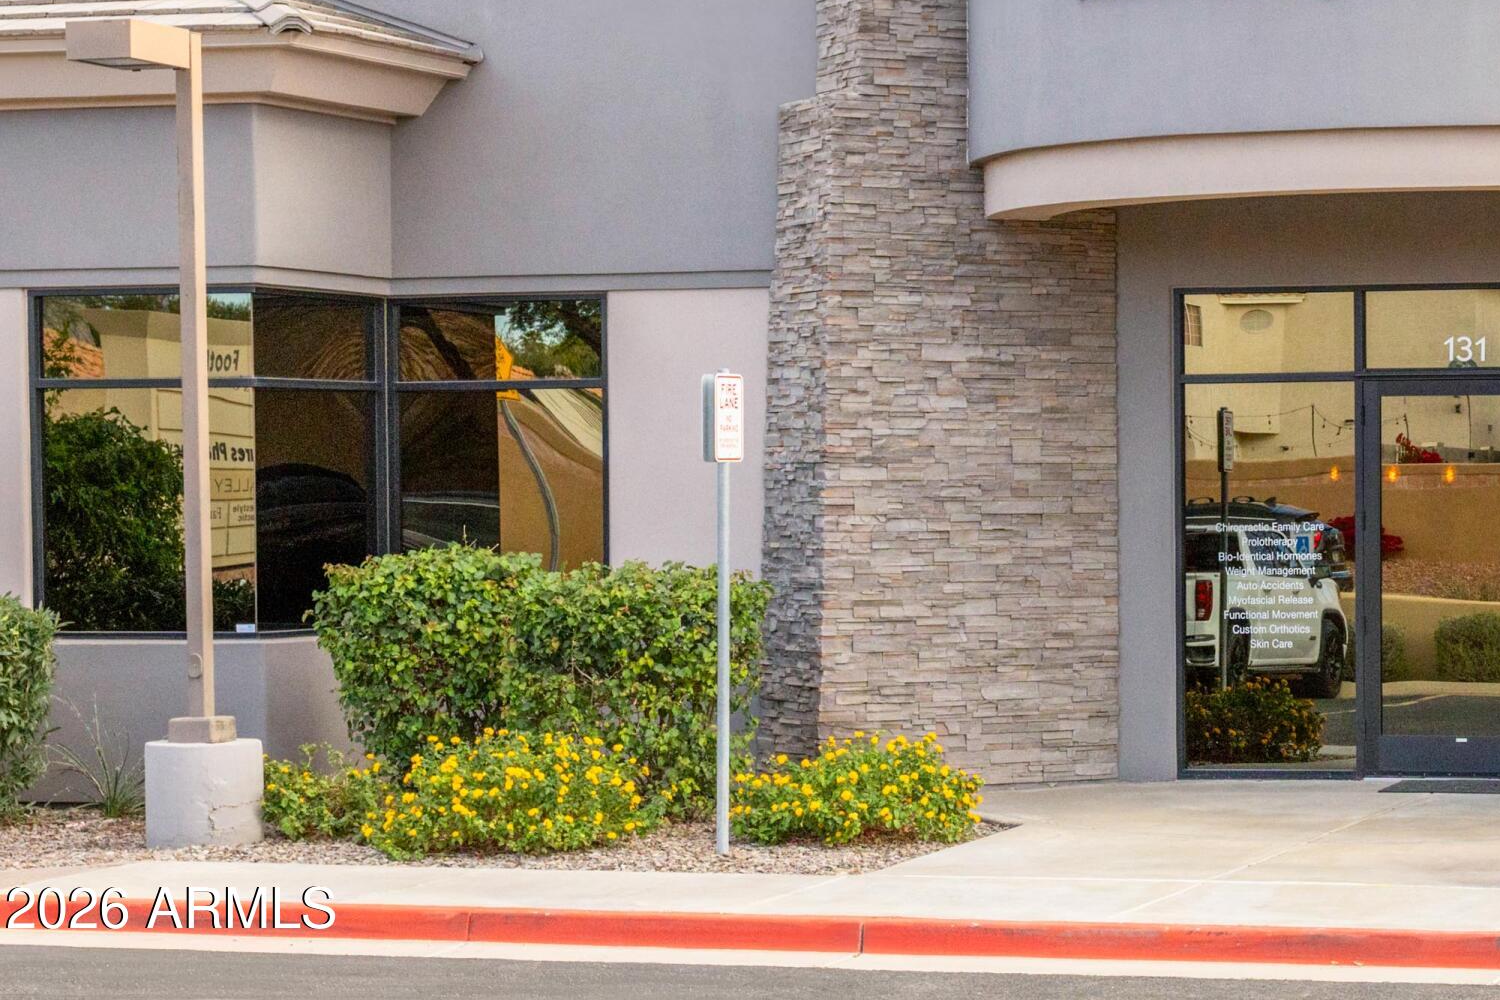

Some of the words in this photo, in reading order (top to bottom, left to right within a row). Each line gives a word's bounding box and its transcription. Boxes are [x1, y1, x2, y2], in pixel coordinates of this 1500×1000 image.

[1443, 335, 1486, 361] 131
[1215, 522, 1270, 533] Chiropractic
[1272, 522, 1301, 533] Family
[1303, 521, 1325, 531] Care
[1242, 537, 1298, 549] Prolotherapy
[1218, 551, 1274, 561] Bio-Identical
[1276, 551, 1323, 561] Hormones
[1225, 566, 1256, 577] Weight
[1258, 566, 1316, 577] Management
[1237, 581, 1258, 590] Auto
[1260, 581, 1305, 590] Accidents
[1228, 595, 1276, 606] Myofascial
[1278, 595, 1314, 604] Release
[1223, 610, 1270, 620] Functional
[1272, 609, 1318, 619] Movement
[1232, 624, 1267, 634] Custom
[1269, 624, 1311, 634] Orthotics
[1250, 639, 1270, 649] Skin
[1272, 639, 1294, 649] Care
